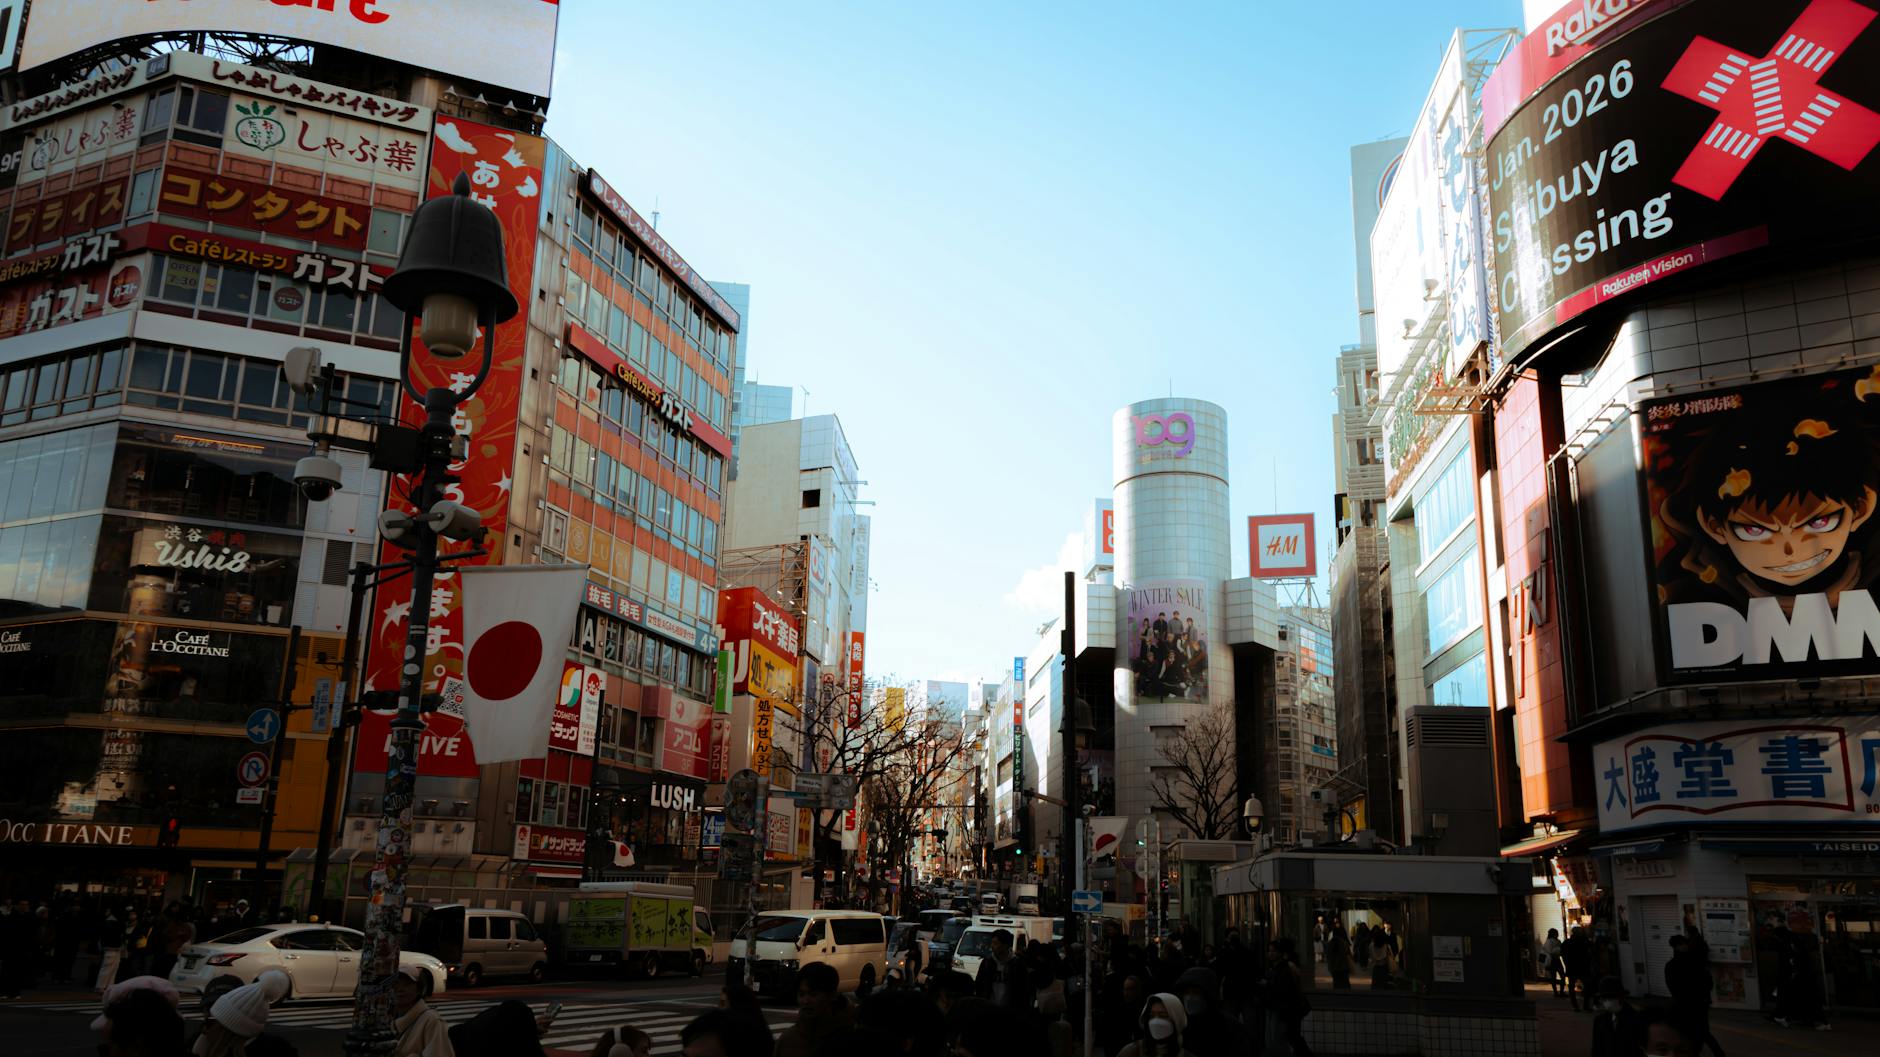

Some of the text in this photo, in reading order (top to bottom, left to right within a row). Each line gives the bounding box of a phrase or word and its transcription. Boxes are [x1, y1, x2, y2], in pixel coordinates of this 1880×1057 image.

[1546, 0, 1628, 56] Raku
[212, 61, 419, 122] しゃぶしゃぶバイキング
[64, 107, 136, 155] しゃぶ葉
[297, 120, 418, 172] しゃぶ葉
[1492, 137, 1540, 191] Jan.
[1542, 59, 1635, 145] 2026
[1, 152, 21, 171] 9F
[12, 184, 123, 241] プライス
[163, 173, 362, 236] コンタクト
[1496, 138, 1639, 255] Shibuya
[0, 232, 120, 282] aféレストラン ガスト
[296, 253, 385, 292] ガスト
[1501, 191, 1674, 314] Cossing
[1602, 251, 1693, 297] Rakuten Vision
[25, 284, 100, 333] ガスト
[660, 391, 693, 431] ガスト
[1131, 413, 1196, 458] 109
[155, 541, 251, 574] Ushi8
[1266, 535, 1299, 556] H&M
[1131, 588, 1172, 613] WINTER
[700, 633, 715, 652] 4F
[752, 601, 799, 658] スギ薬局
[672, 727, 702, 753] アコム
[651, 784, 696, 813] LUSH
[44, 821, 135, 846] ITANE
